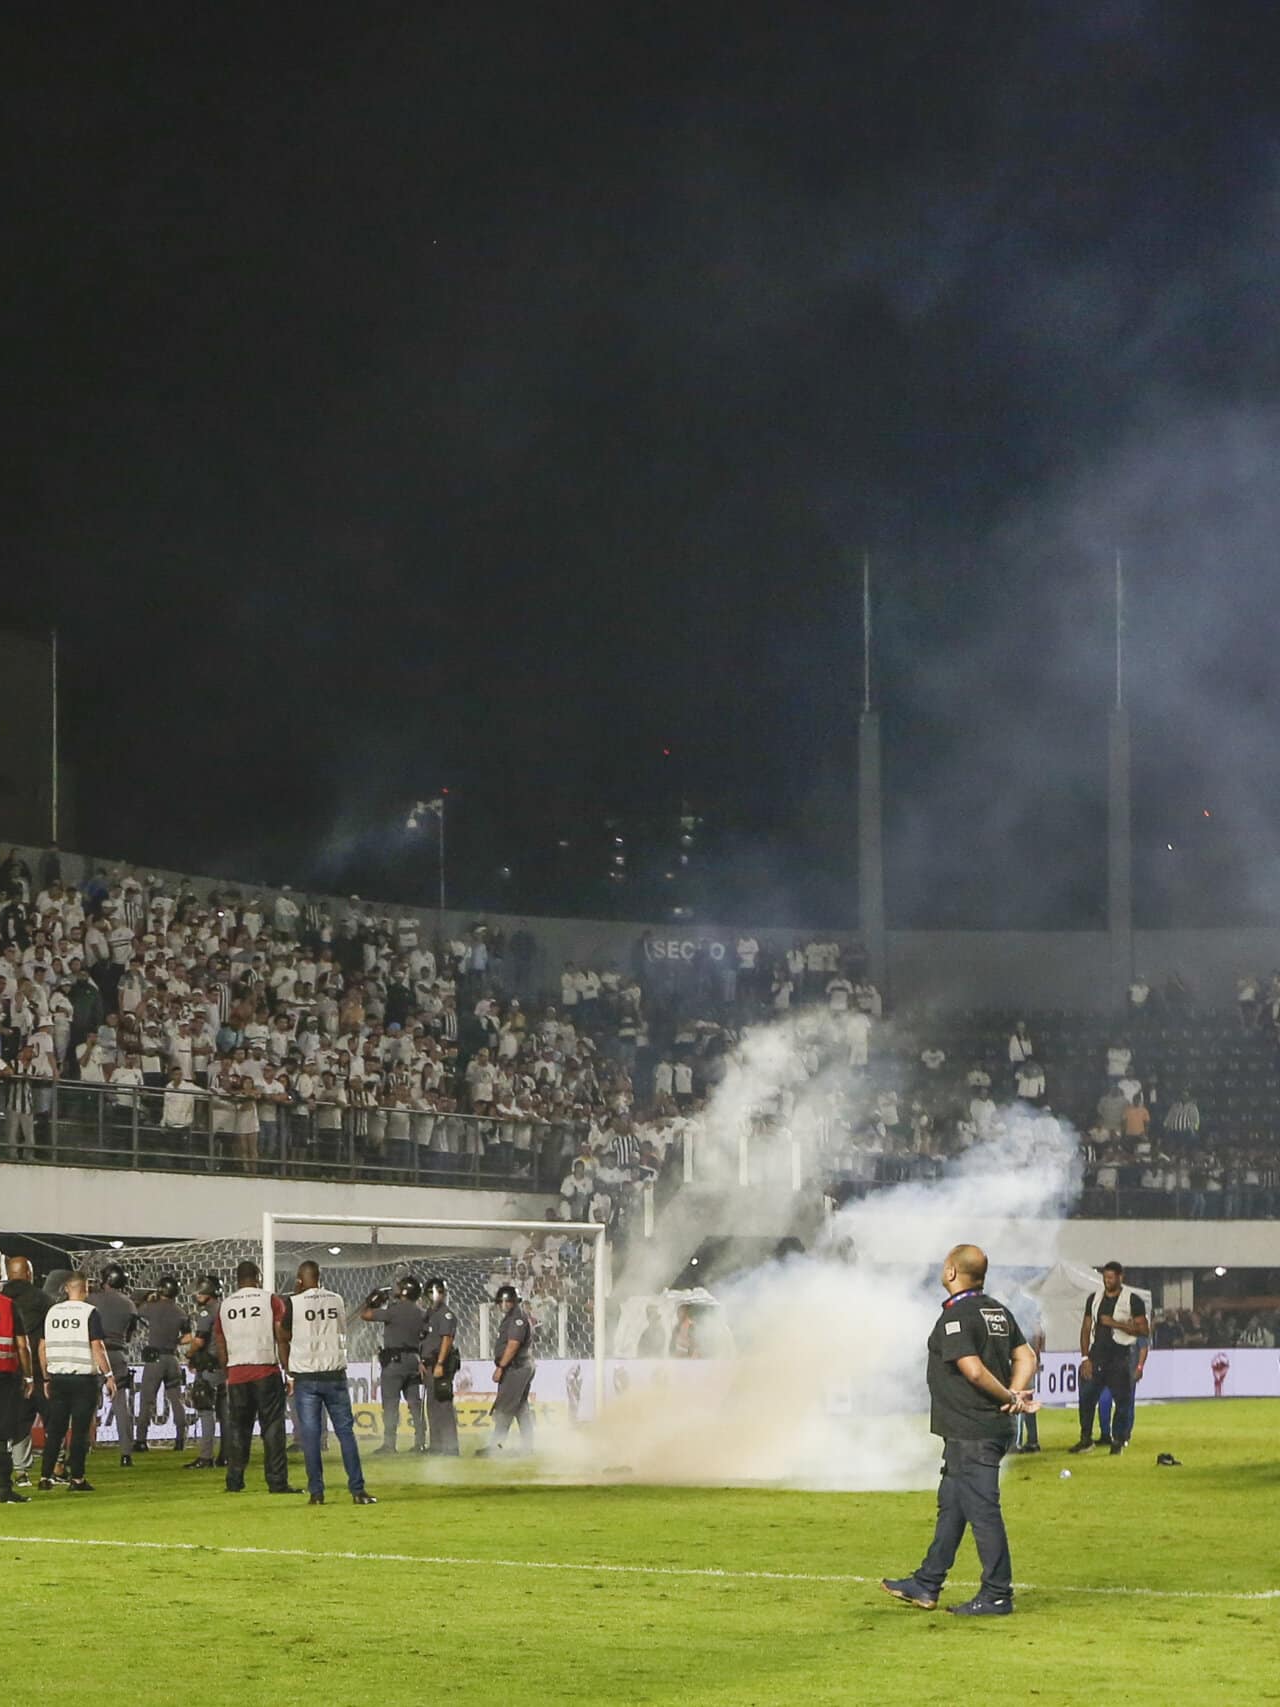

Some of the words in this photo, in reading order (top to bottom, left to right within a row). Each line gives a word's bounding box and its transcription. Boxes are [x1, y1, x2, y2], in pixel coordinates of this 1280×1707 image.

[227, 1306, 261, 1320] 012
[304, 1308, 338, 1321] 015
[52, 1318, 80, 1329] 009
